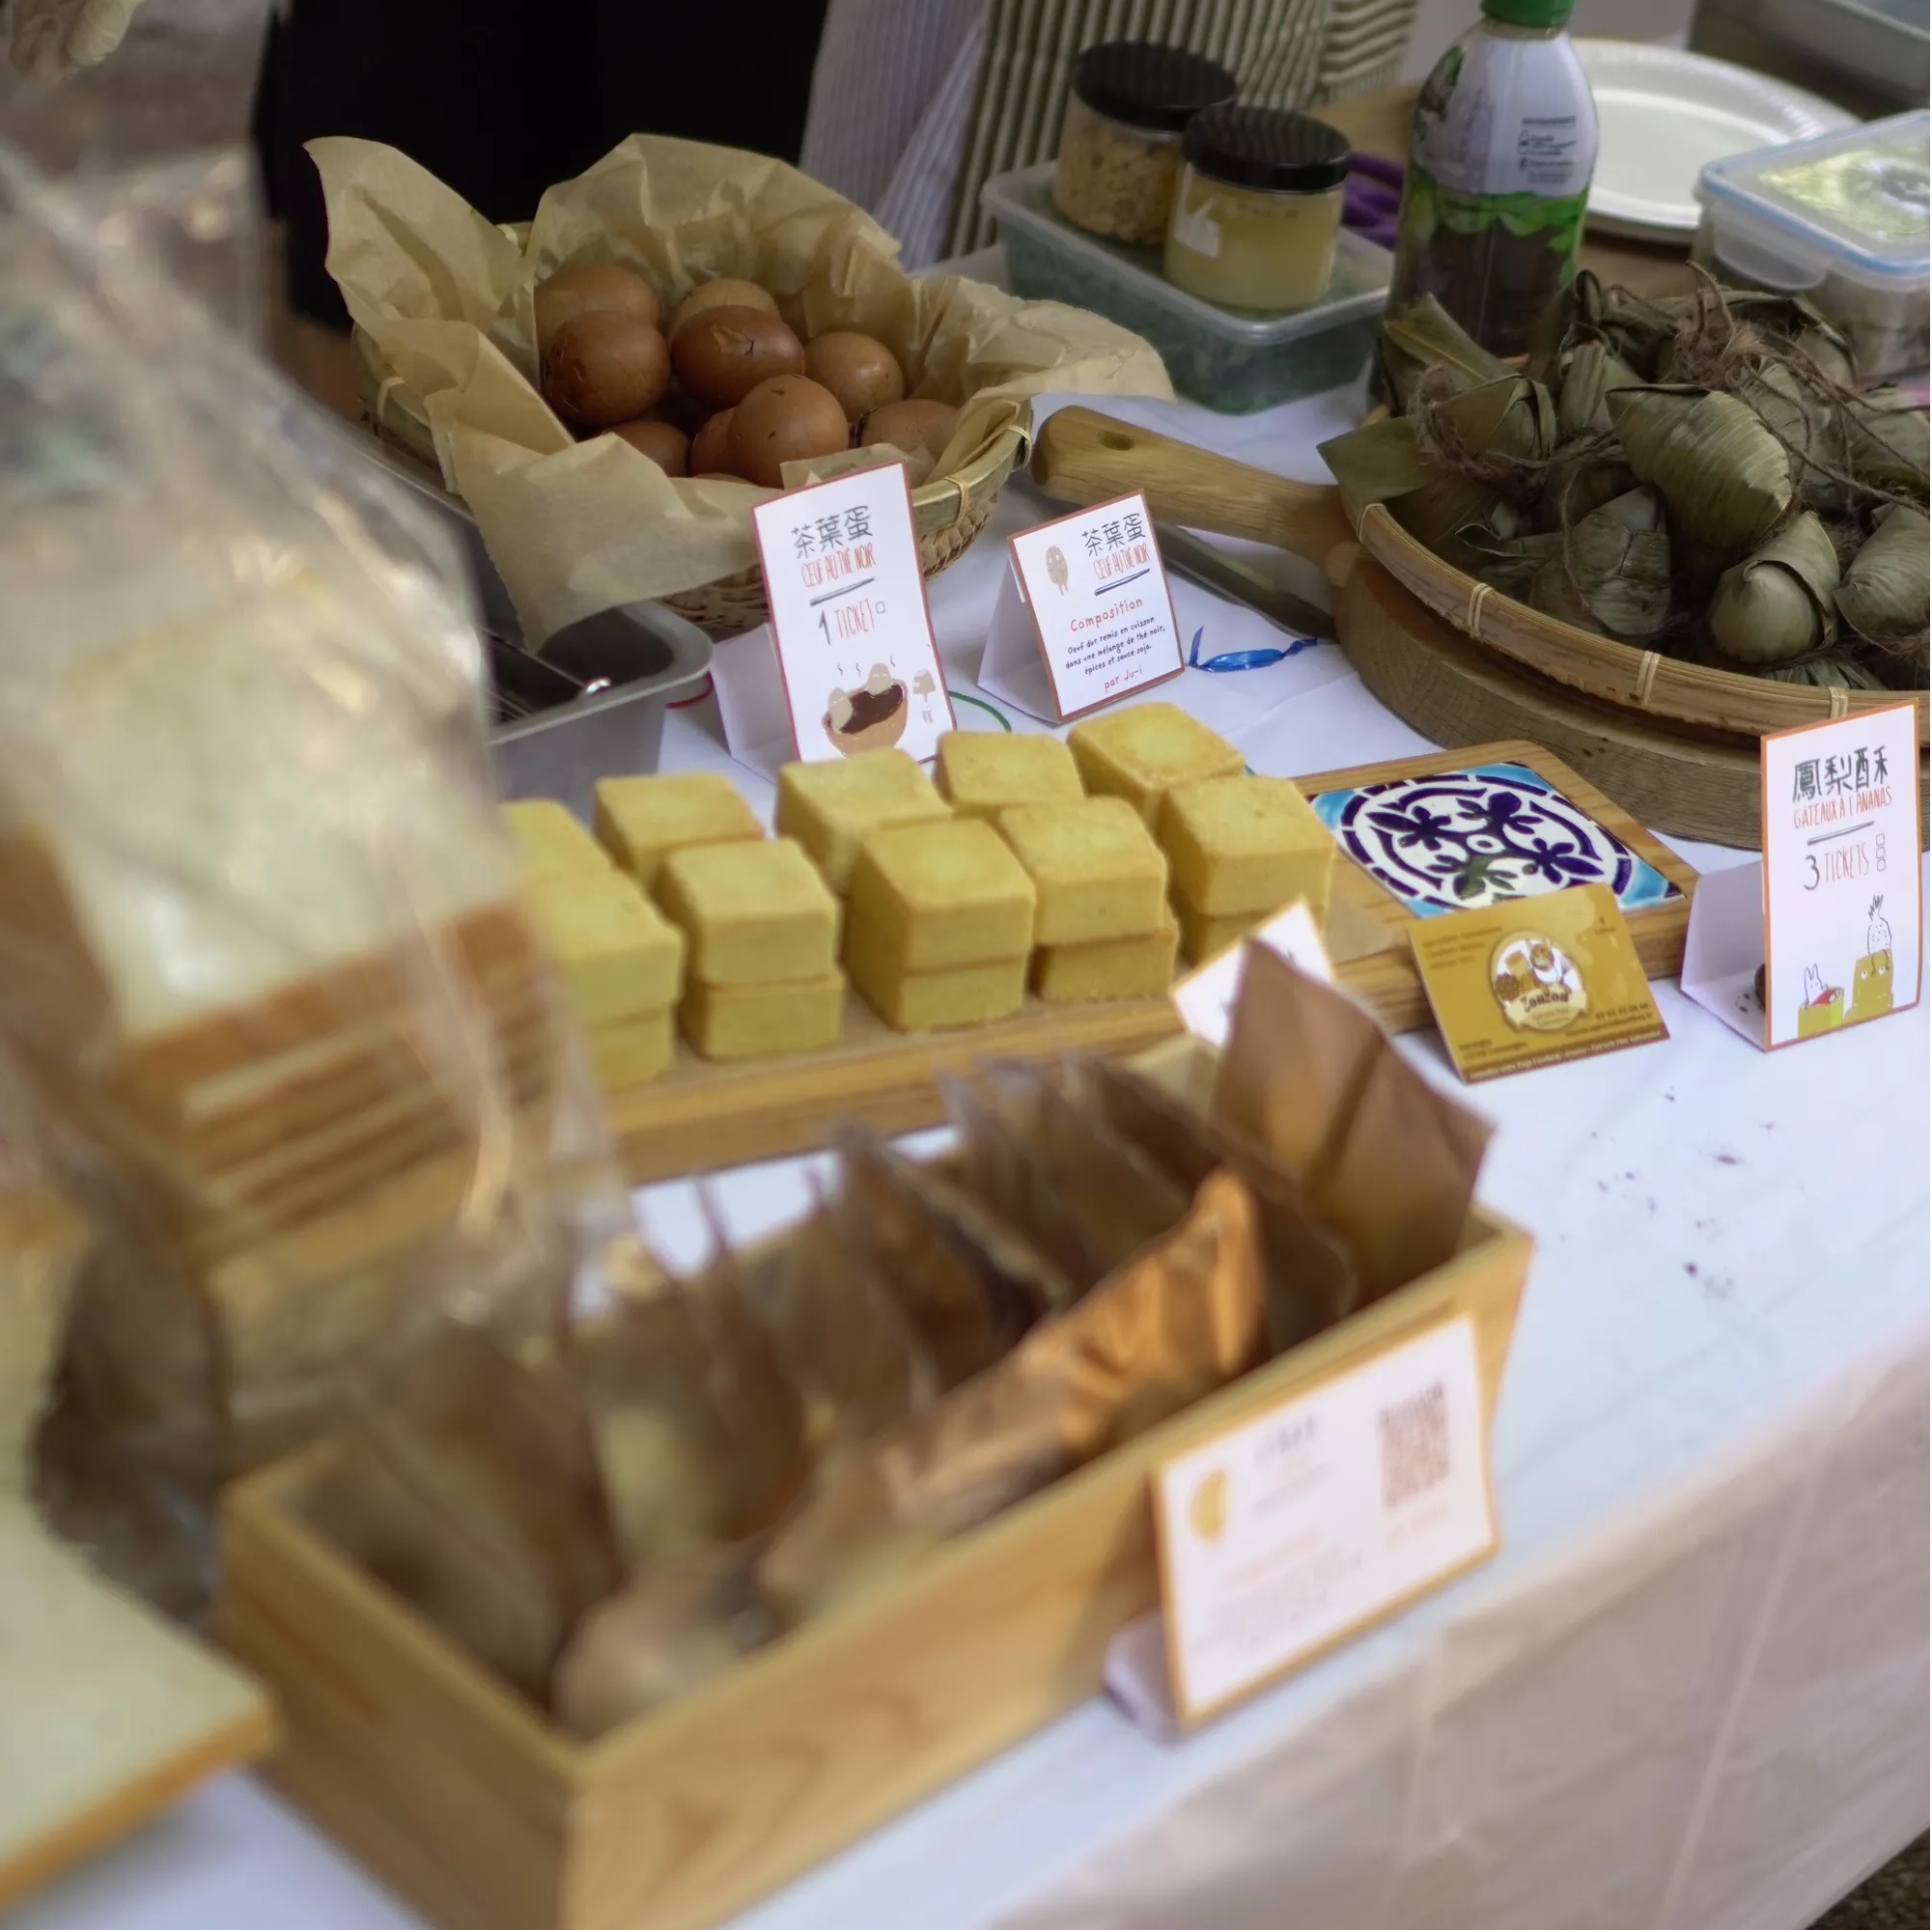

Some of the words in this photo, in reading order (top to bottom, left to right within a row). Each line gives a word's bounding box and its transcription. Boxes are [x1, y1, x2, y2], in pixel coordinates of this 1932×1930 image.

[791, 505, 873, 560] 茶葉蛋
[1081, 513, 1146, 557] 茶葉蛋
[825, 554, 838, 581] AU
[854, 542, 877, 570] NOIR
[1134, 542, 1150, 568] NOIR
[819, 609, 831, 646] 1
[834, 598, 875, 639] TICKET
[1070, 598, 1143, 632] Composition
[1065, 658, 1081, 670] dans
[1083, 653, 1095, 662] une
[1097, 642, 1124, 657] mélange
[1126, 636, 1134, 646] de
[1136, 630, 1147, 641] thé
[1149, 625, 1165, 636] noir,
[1067, 642, 1084, 655] Oeuf
[1086, 637, 1098, 649] dur
[1099, 630, 1118, 644] remis
[1120, 627, 1129, 635] en
[1130, 617, 1155, 630] cuisson
[1084, 661, 1106, 676] épices
[1107, 657, 1115, 666] et
[1116, 651, 1134, 663] sauce
[1136, 644, 1152, 656] soja.
[1104, 676, 1120, 694] par
[1793, 744, 1889, 803] 鳳梨酥
[1803, 854, 1821, 891] 3
[1824, 842, 1870, 884] TICKETS
